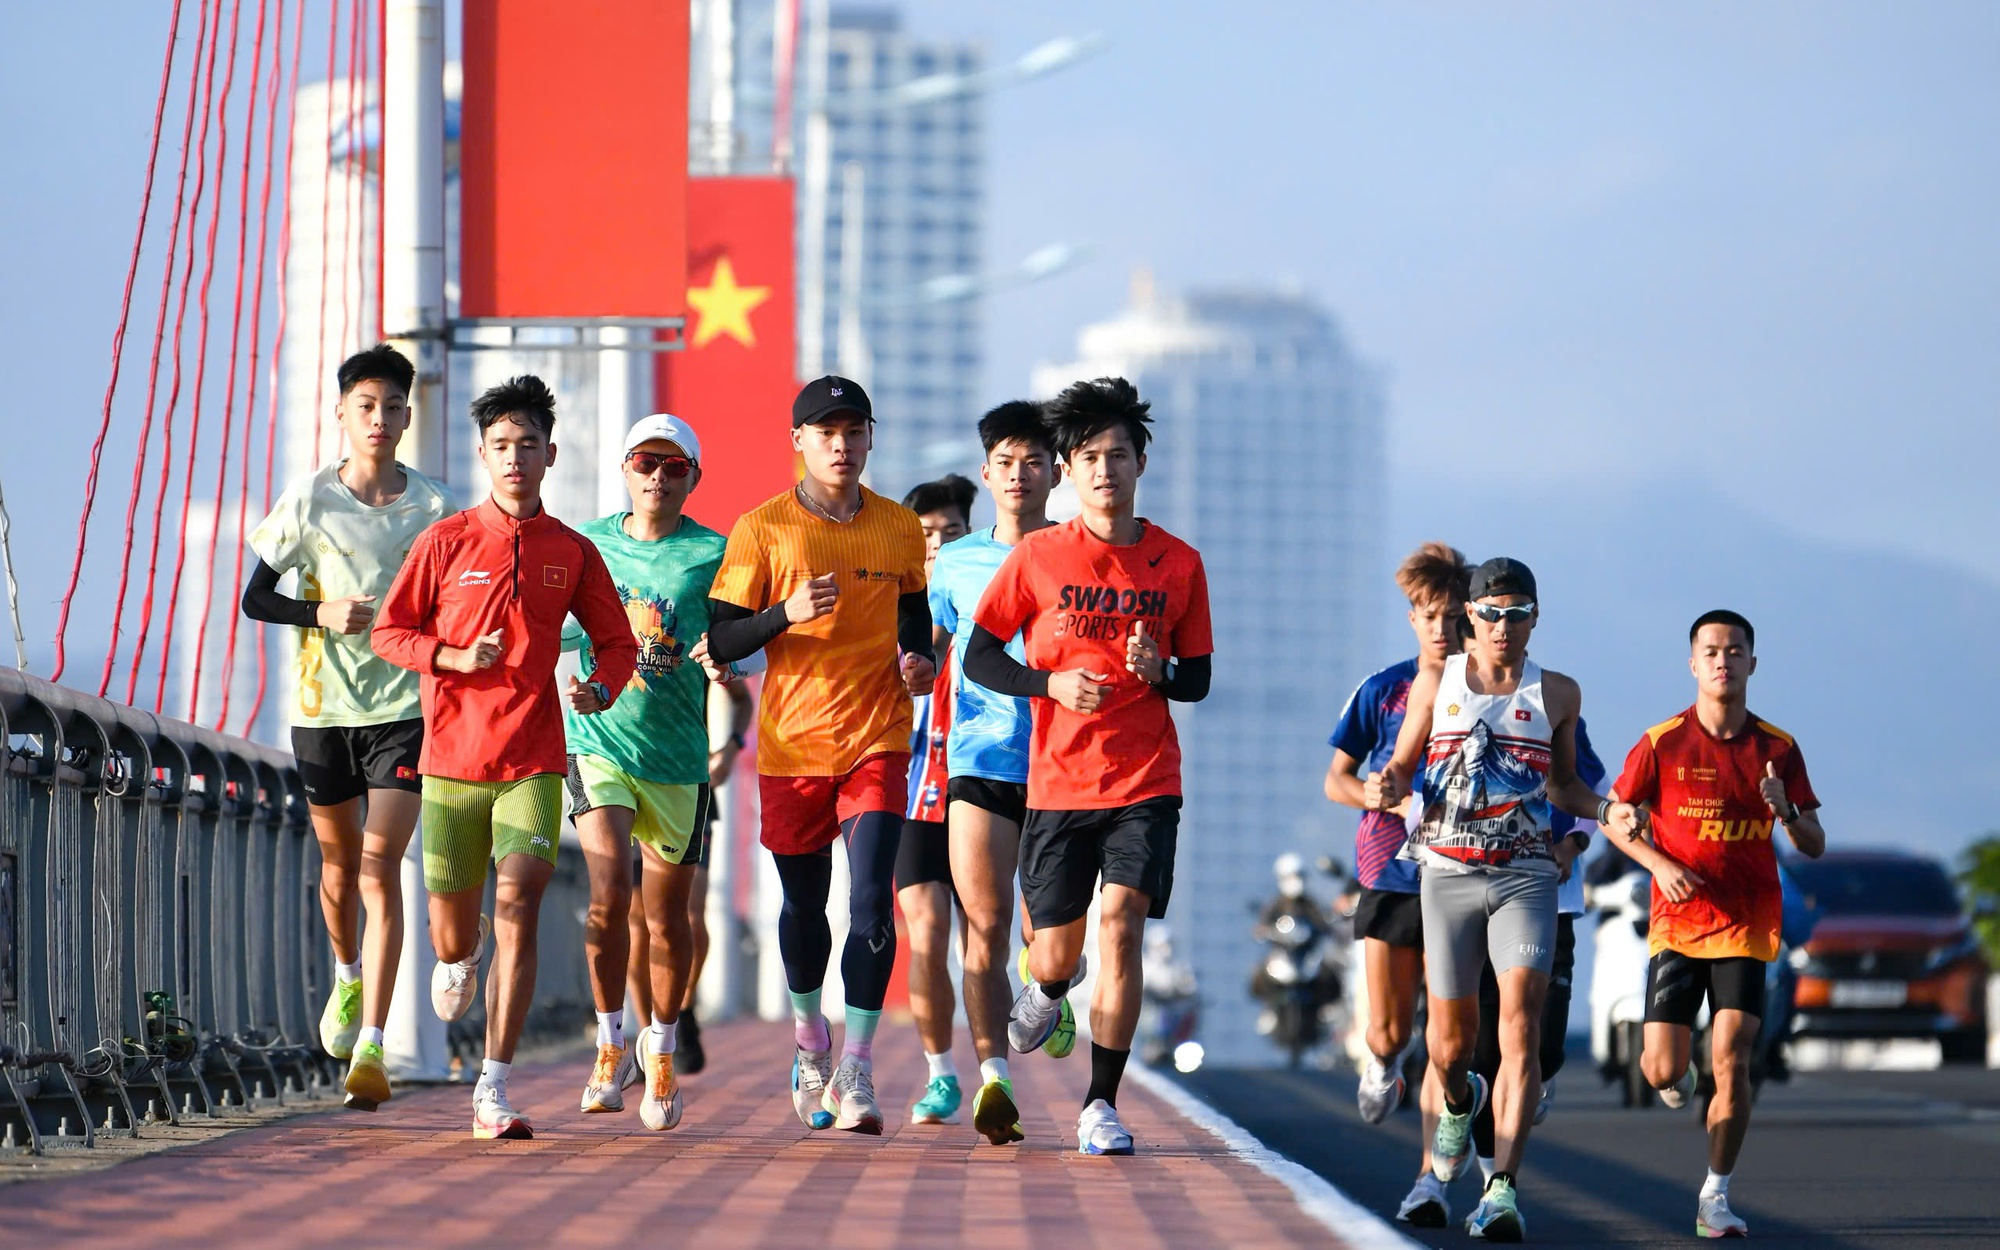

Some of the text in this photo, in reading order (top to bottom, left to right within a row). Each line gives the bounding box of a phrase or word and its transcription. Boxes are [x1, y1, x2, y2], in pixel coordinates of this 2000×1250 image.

[1058, 585, 1167, 618] SWOOSH
[1054, 613, 1121, 641] SPORTS
[650, 653, 673, 667] PARK
[1688, 797, 1725, 807] TAM CHÚC
[1677, 806, 1725, 818] NIGHT
[1697, 819, 1773, 841] RUN
